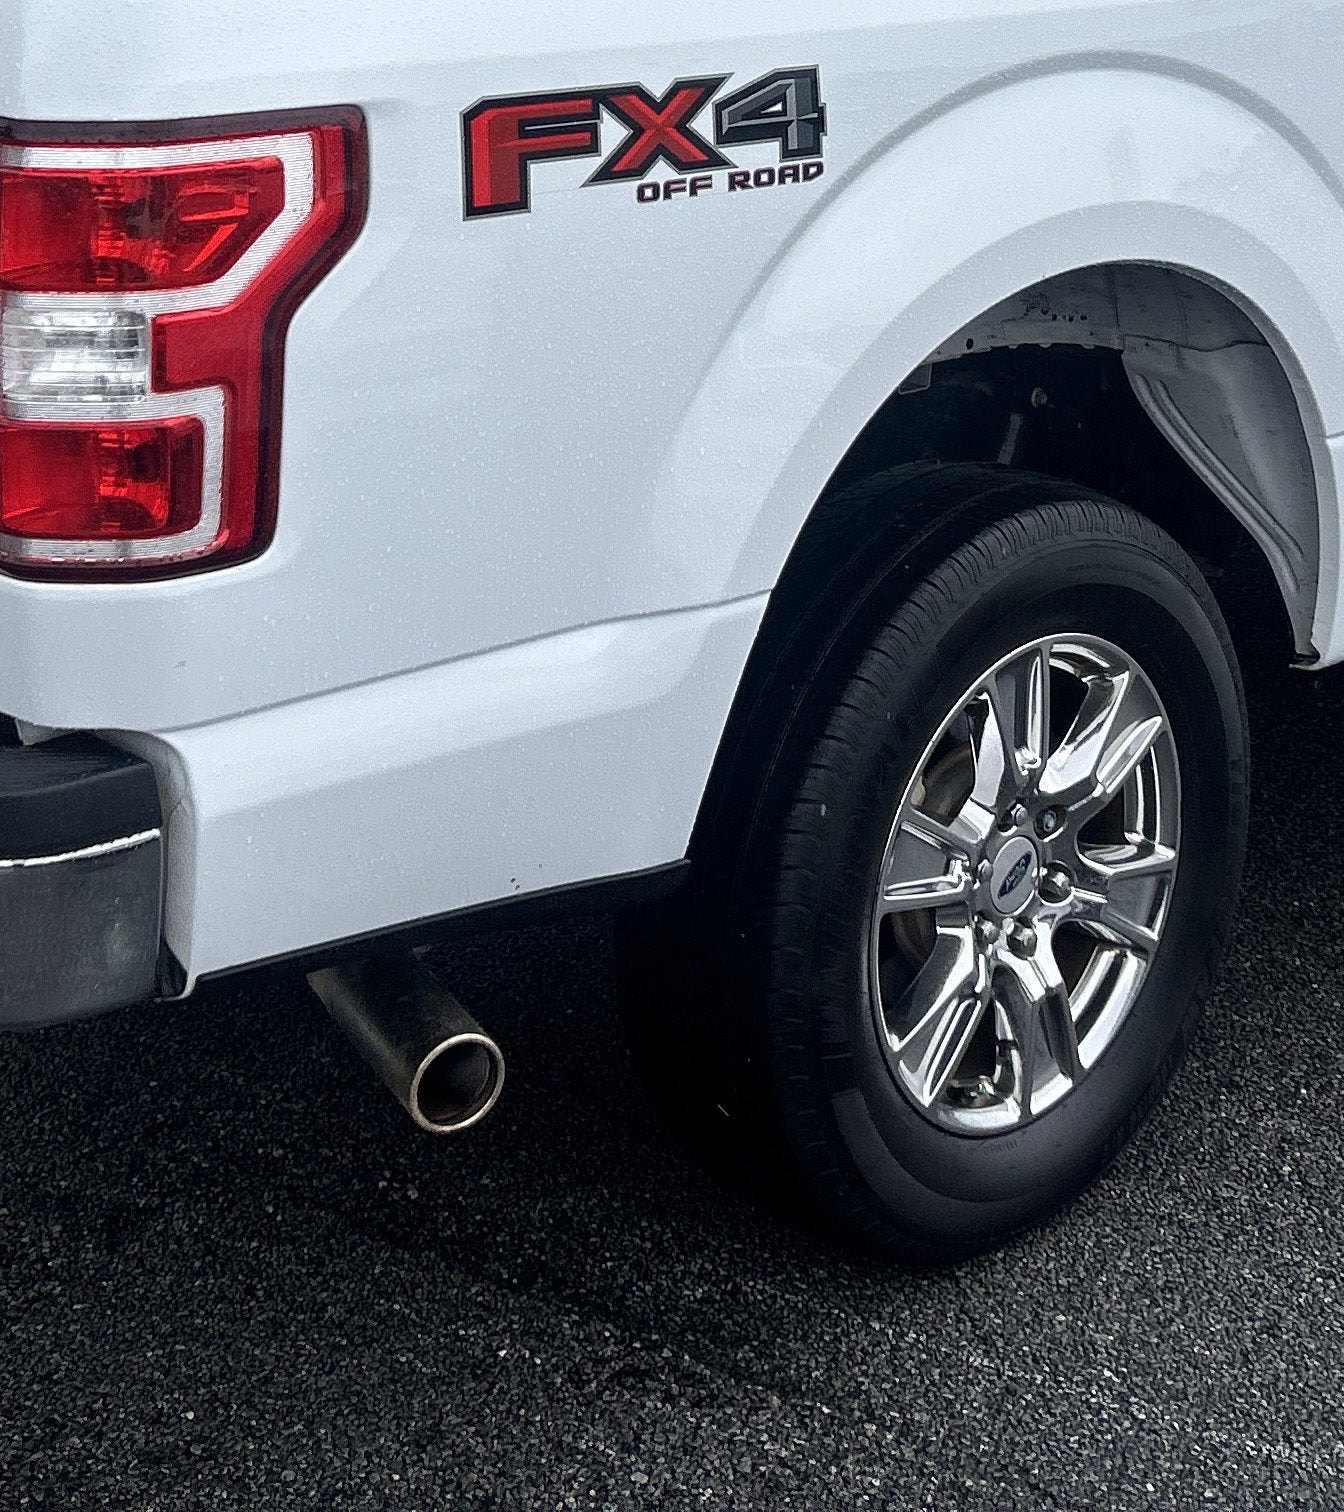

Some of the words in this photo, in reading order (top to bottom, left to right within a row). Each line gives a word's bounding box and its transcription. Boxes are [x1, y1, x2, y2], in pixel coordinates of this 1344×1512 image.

[460, 64, 827, 221] FX4
[636, 175, 713, 204] OFF
[727, 160, 825, 192] ROAD
